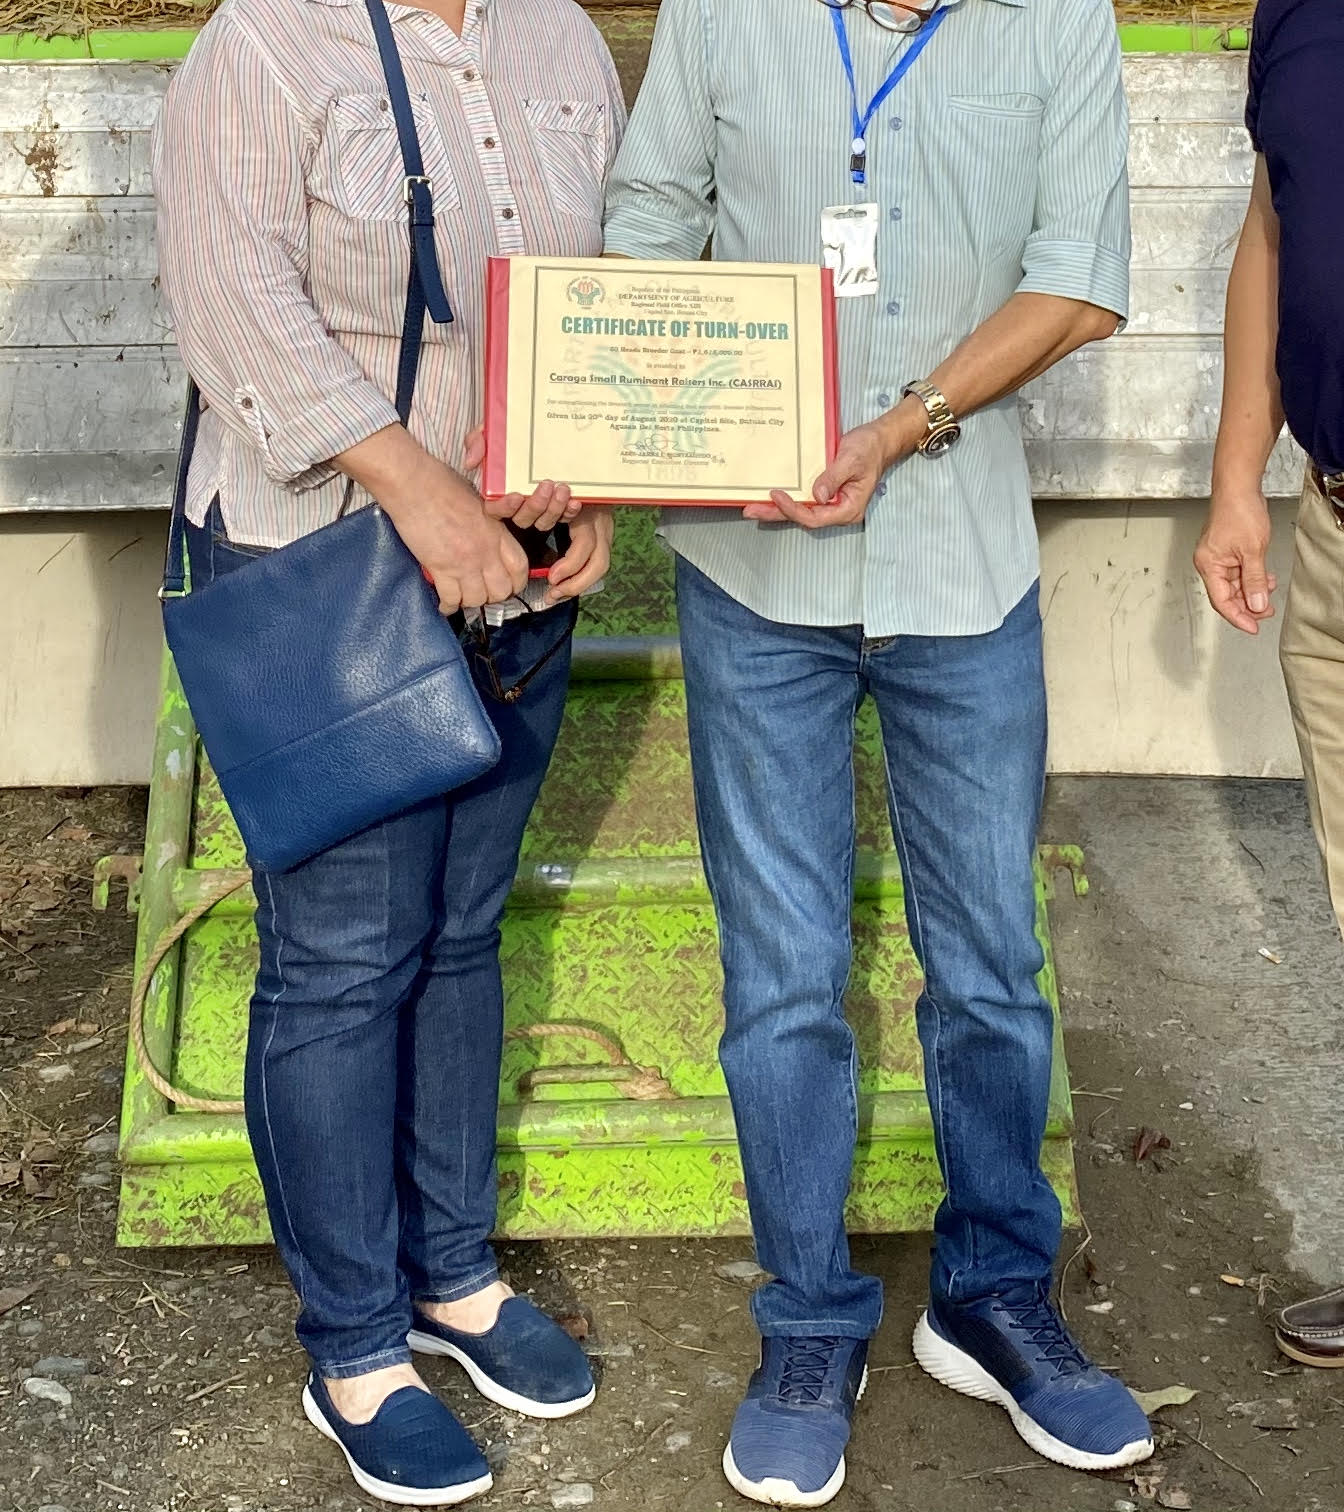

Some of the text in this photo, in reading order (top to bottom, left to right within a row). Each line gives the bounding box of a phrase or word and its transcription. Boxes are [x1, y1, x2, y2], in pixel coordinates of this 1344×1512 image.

[561, 315, 789, 340] CERTIFICATE OF TURN-OVER
[549, 372, 782, 390] Caraga Small Ruminant Raisers Inc. (CASRRAI)
[546, 412, 569, 420] Given
[605, 414, 619, 422] day
[630, 415, 657, 424] August
[768, 418, 785, 427] City
[609, 423, 637, 431] Agusan
